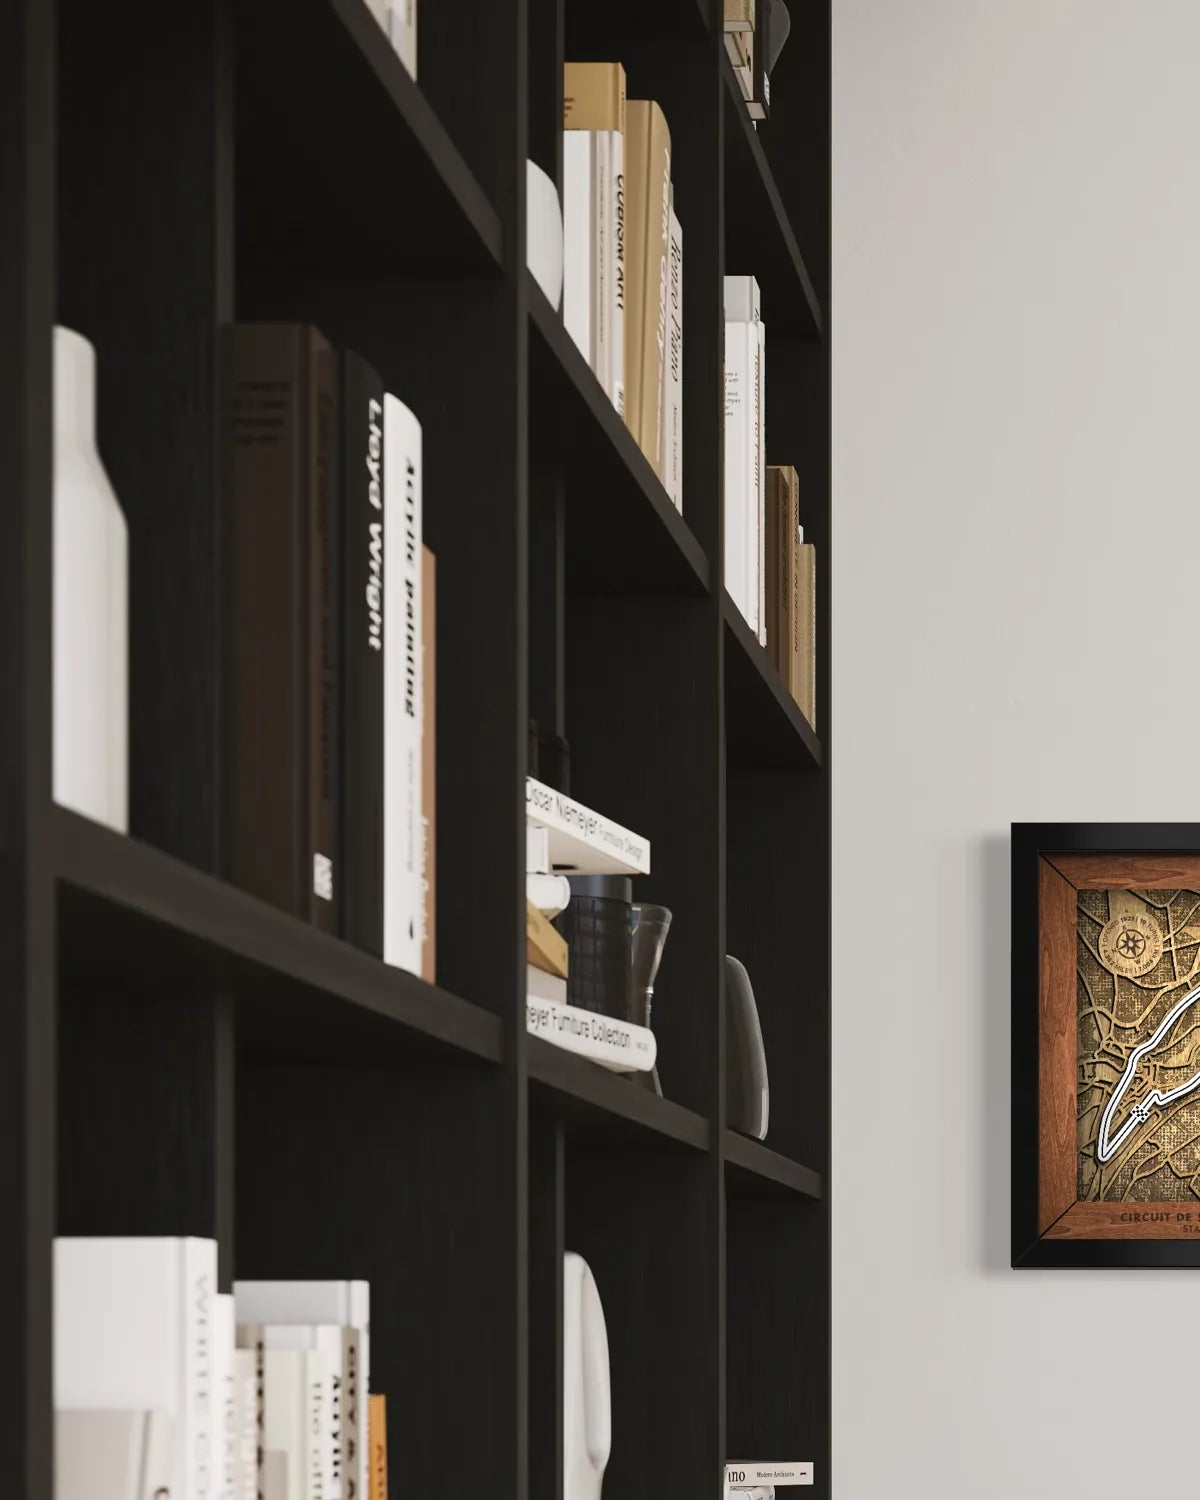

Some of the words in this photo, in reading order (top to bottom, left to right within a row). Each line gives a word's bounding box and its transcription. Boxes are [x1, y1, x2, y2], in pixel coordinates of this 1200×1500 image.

[671, 236, 681, 309] Renzo
[671, 313, 682, 383] Piano
[366, 398, 382, 511] Lloyd
[366, 521, 382, 651] Wright
[555, 795, 599, 838] Niemeyer
[1120, 1212, 1170, 1222] CIRCUIT
[1176, 1212, 1192, 1222] DE
